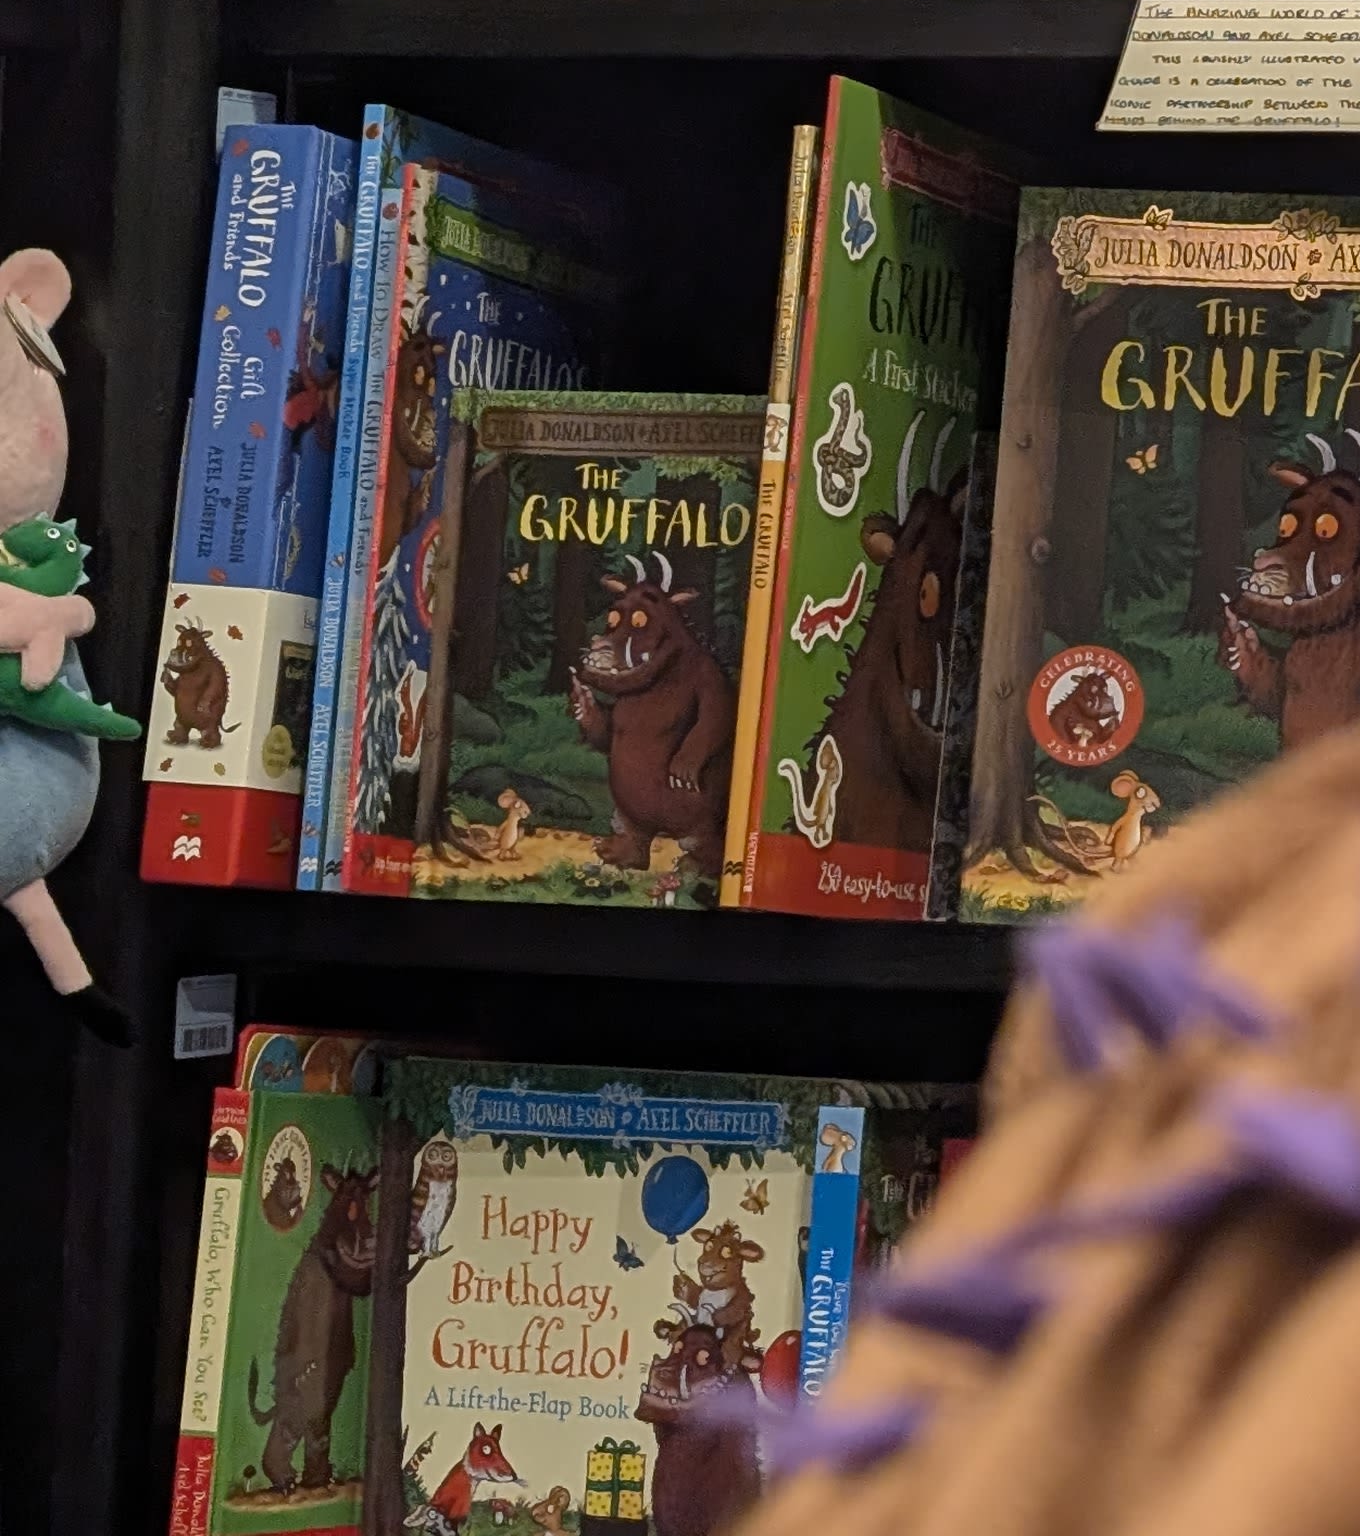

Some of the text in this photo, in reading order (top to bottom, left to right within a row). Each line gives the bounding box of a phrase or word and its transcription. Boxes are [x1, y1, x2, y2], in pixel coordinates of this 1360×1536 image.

[1145, 2, 1175, 19] THE
[1270, 7, 1326, 20] WORLD
[1329, 7, 1351, 20] OF
[280, 180, 297, 209] THE
[223, 173, 248, 272] and Friends
[238, 148, 282, 308] GRUFFALO
[354, 181, 377, 270] GRUFFALO
[1095, 235, 1160, 269] JULIA
[1166, 238, 1299, 272] DONALDSON
[476, 292, 502, 326] THE
[1197, 296, 1269, 339] THE
[212, 325, 242, 430] Collection
[240, 356, 266, 400] Gift
[359, 400, 384, 492] GRUFFALO
[489, 419, 535, 446] JULIA
[540, 418, 638, 443] DONALDSON
[237, 442, 256, 482] JULIA
[575, 462, 622, 491] THE
[519, 494, 751, 548] GRUFFALO
[754, 479, 777, 590] THE GRUFFALO
[1040, 650, 1136, 693] CELEBRATING
[1067, 741, 1118, 762] YEARS
[843, 871, 917, 904] easy-to-use
[475, 1097, 771, 1136] JULIA DONALDSON AXEL SCHEFFLER
[480, 1193, 595, 1256] Happy
[191, 1185, 231, 1424] Gruffalo, Who Can You See?
[447, 1259, 619, 1322] Birthday,
[432, 1315, 631, 1381] Gruffalo!
[803, 1273, 834, 1398] GRUFFALO
[424, 1385, 630, 1421] A Lift-the-Flap Book
